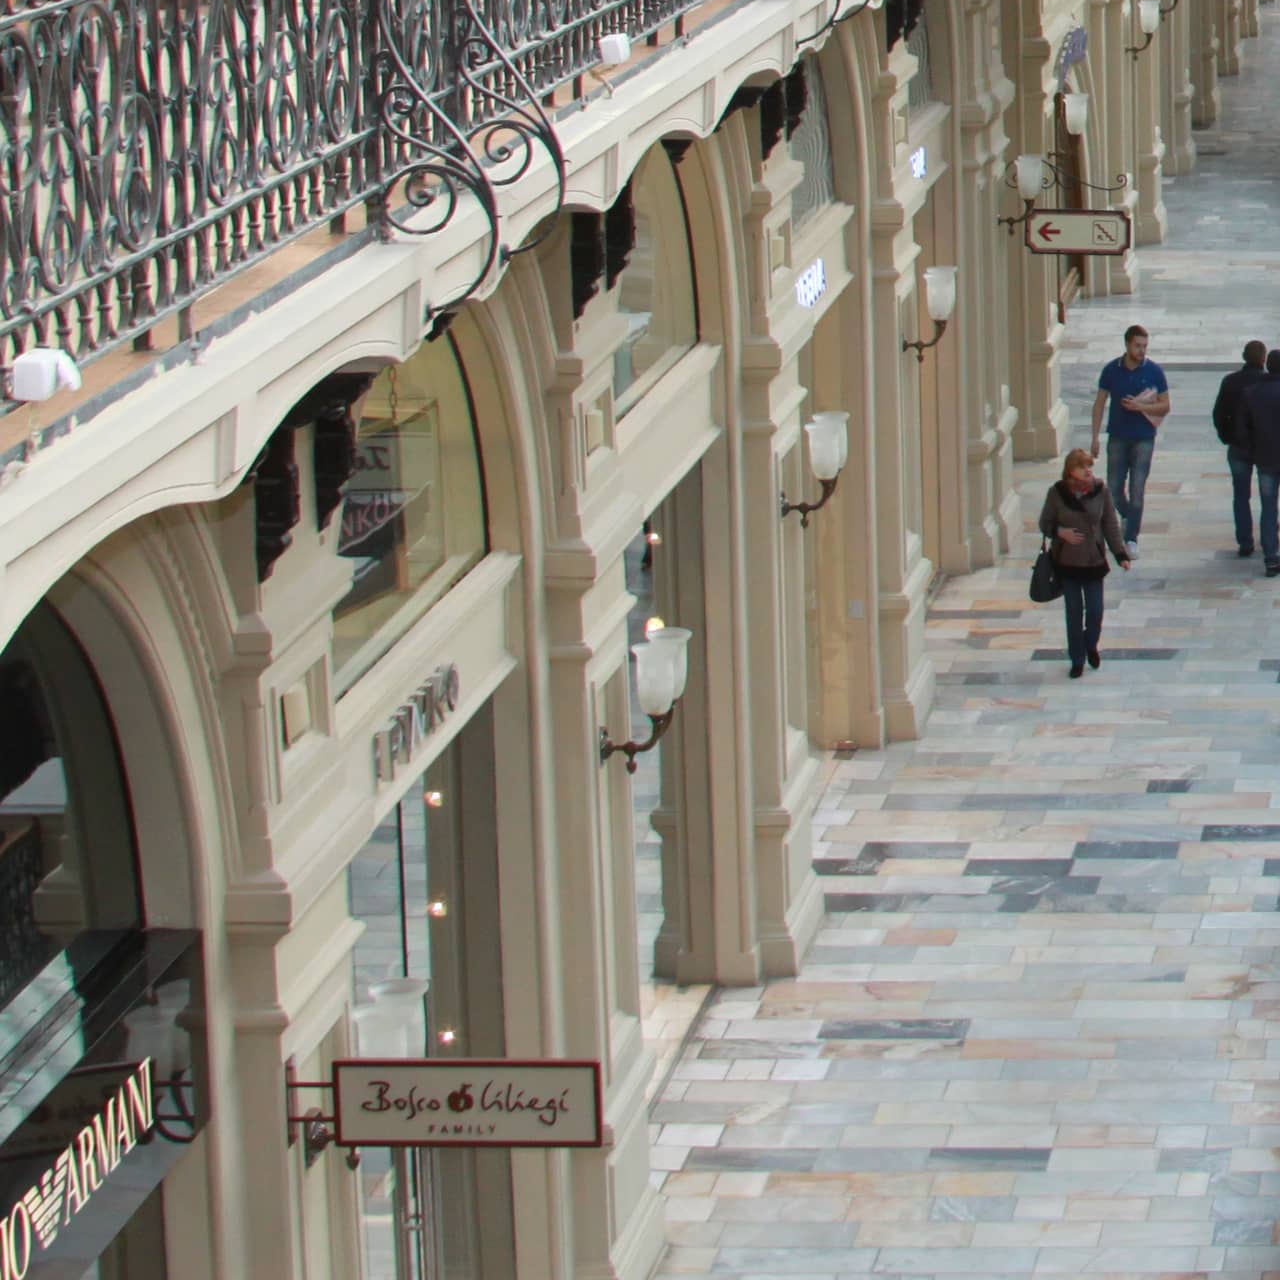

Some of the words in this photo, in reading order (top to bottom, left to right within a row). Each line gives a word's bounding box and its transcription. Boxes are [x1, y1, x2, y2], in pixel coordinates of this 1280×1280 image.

[361, 1080, 441, 1120] Bosco
[481, 1080, 570, 1126] Ciliegi
[64, 1056, 154, 1226] ARMANI
[428, 1124, 497, 1134] FAMILY
